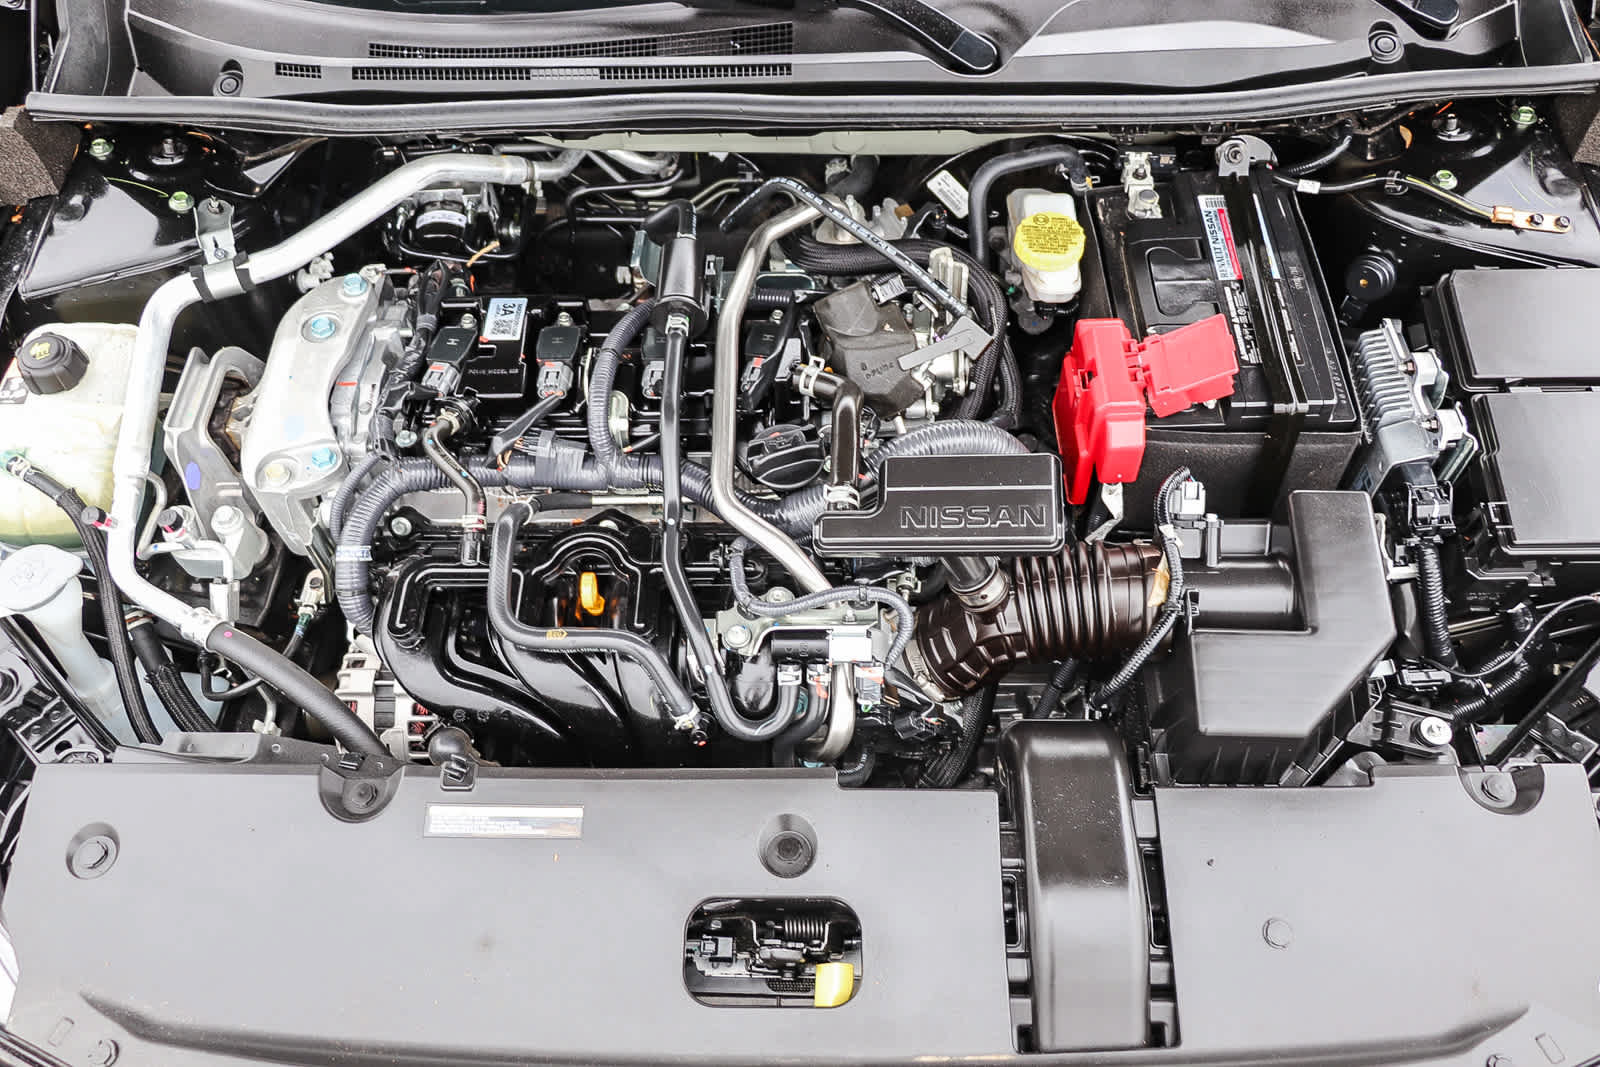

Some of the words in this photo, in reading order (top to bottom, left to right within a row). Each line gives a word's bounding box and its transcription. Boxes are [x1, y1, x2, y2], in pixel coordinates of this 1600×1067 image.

[1204, 210, 1220, 244] NISSAN
[501, 303, 516, 316] 3A
[900, 504, 1046, 528] NISSAN
